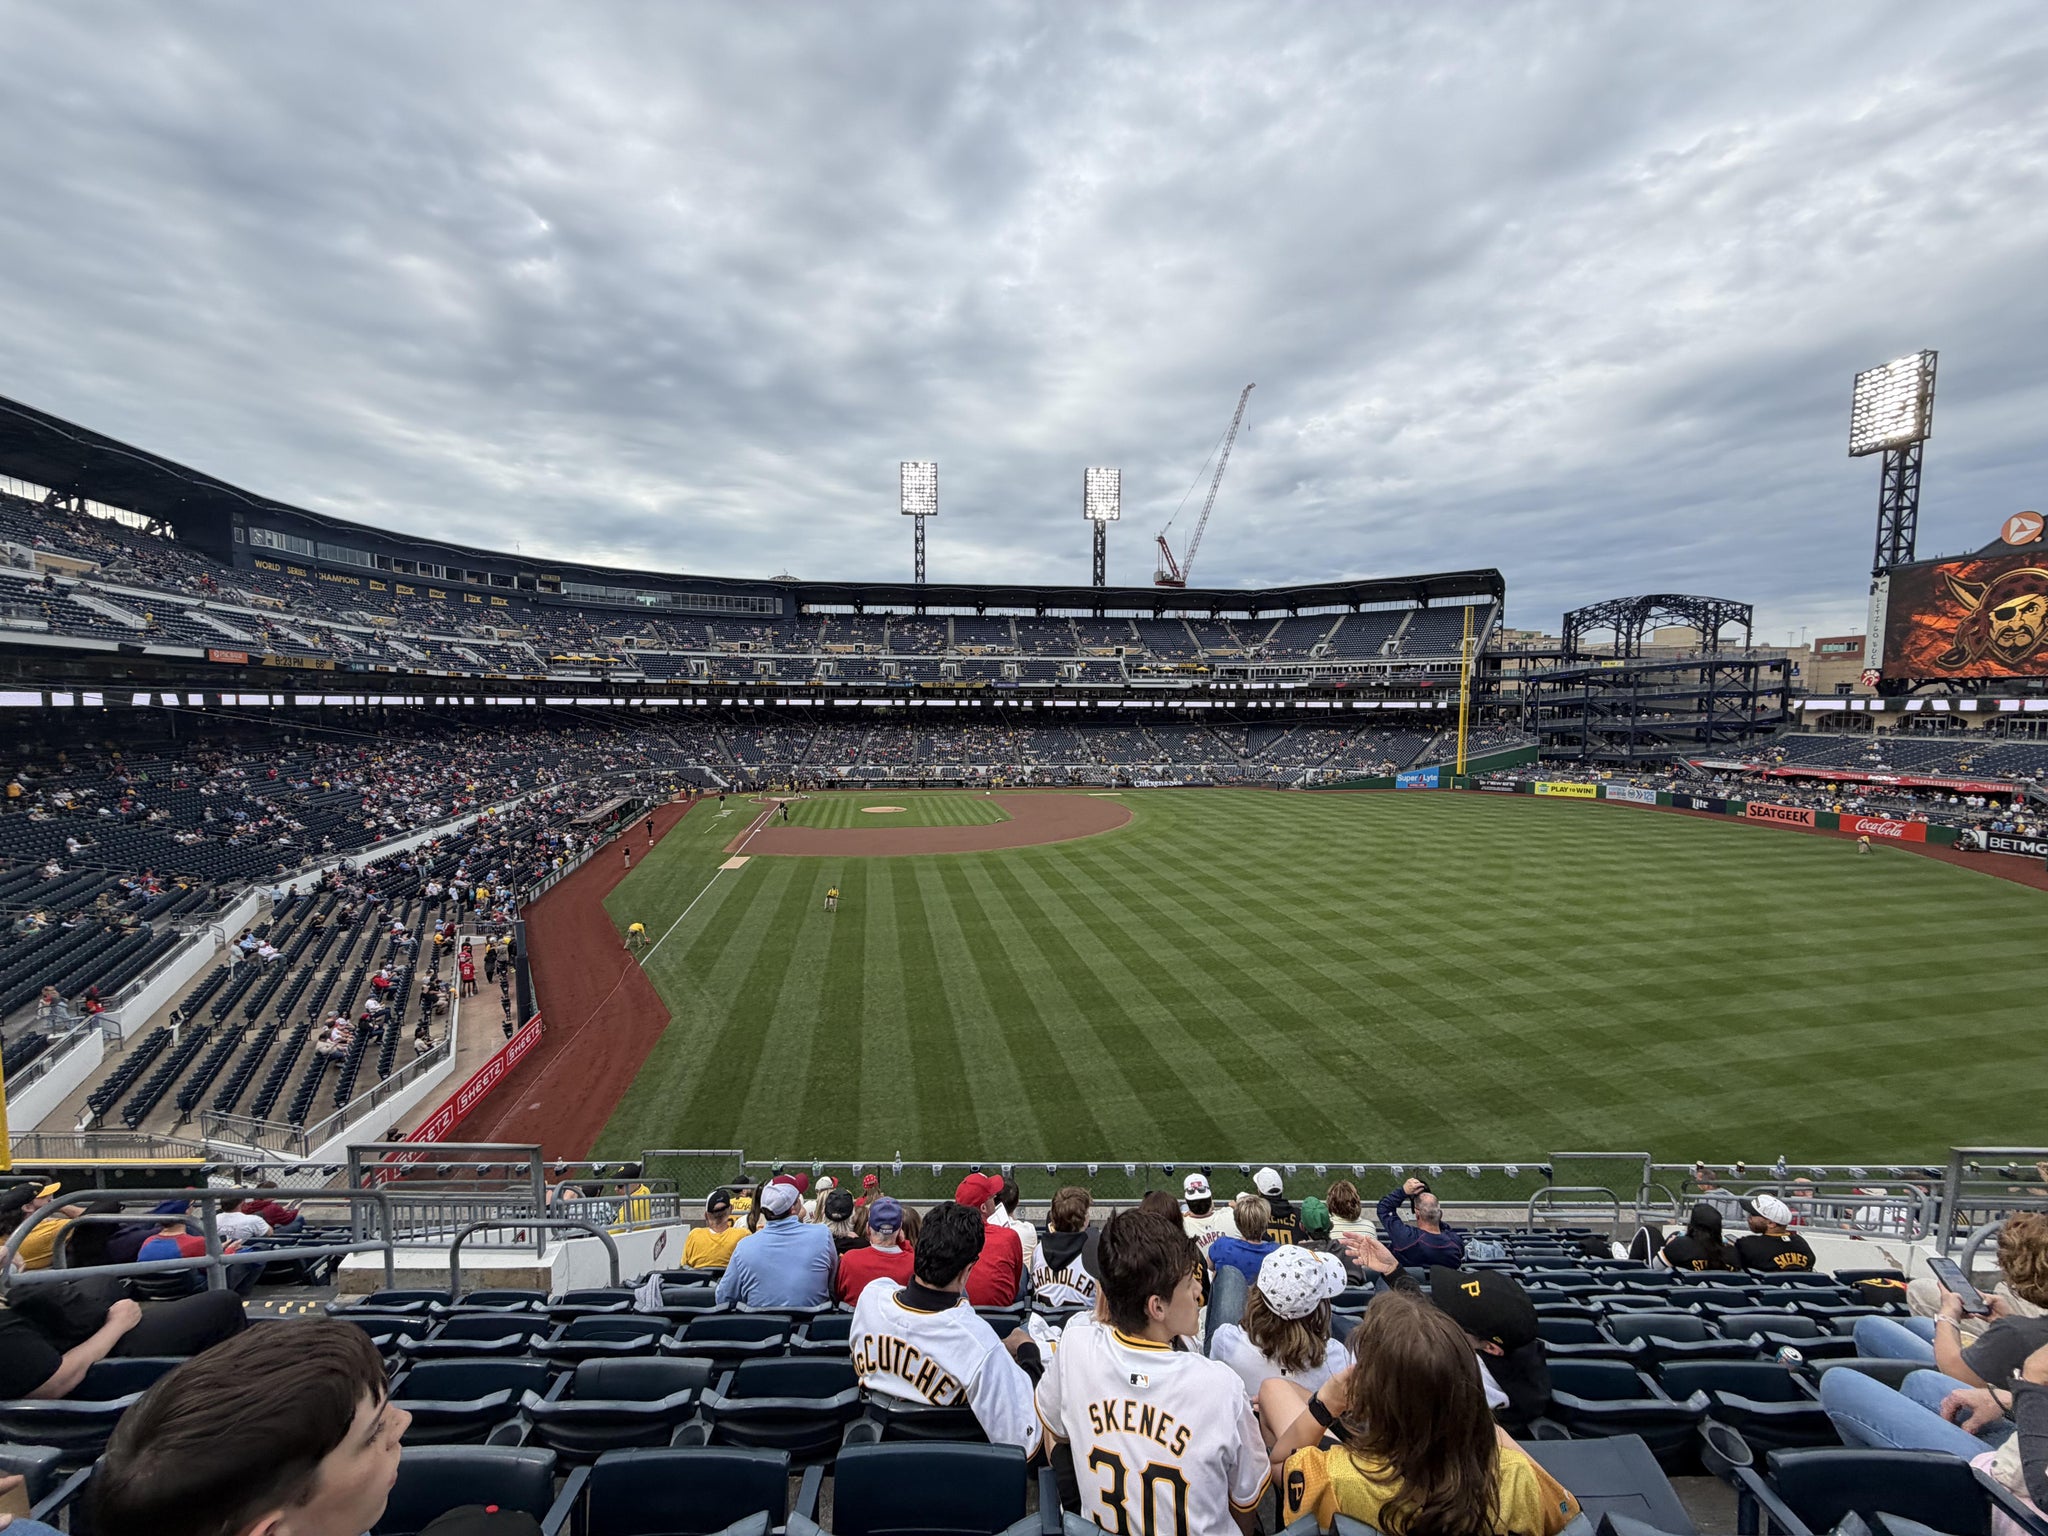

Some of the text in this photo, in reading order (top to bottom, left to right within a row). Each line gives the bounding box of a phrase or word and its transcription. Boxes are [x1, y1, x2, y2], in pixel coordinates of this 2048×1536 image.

[254, 559, 360, 586] WORLD SERIES CHAMPIONS
[275, 656, 292, 666] 6:23
[293, 657, 304, 667] PM
[1134, 779, 1164, 788] Chicken
[1397, 773, 1438, 784] Super Lyte
[1576, 787, 1594, 795] WIN!
[1643, 791, 1655, 801] 125
[1692, 798, 1709, 810] Lite
[1750, 804, 1810, 825] SEATGEEK
[1855, 818, 1905, 838] Coca-Cola
[508, 1021, 541, 1062] SHEETZ
[460, 1063, 501, 1109] SHEETZ
[1773, 1252, 1809, 1270] SKENES
[1030, 1266, 1095, 1298] CHANDLER
[1461, 1280, 1481, 1297] P
[1088, 1398, 1192, 1459] SKENES
[1087, 1444, 1191, 1536] 30
[1290, 1482, 1304, 1501] P
